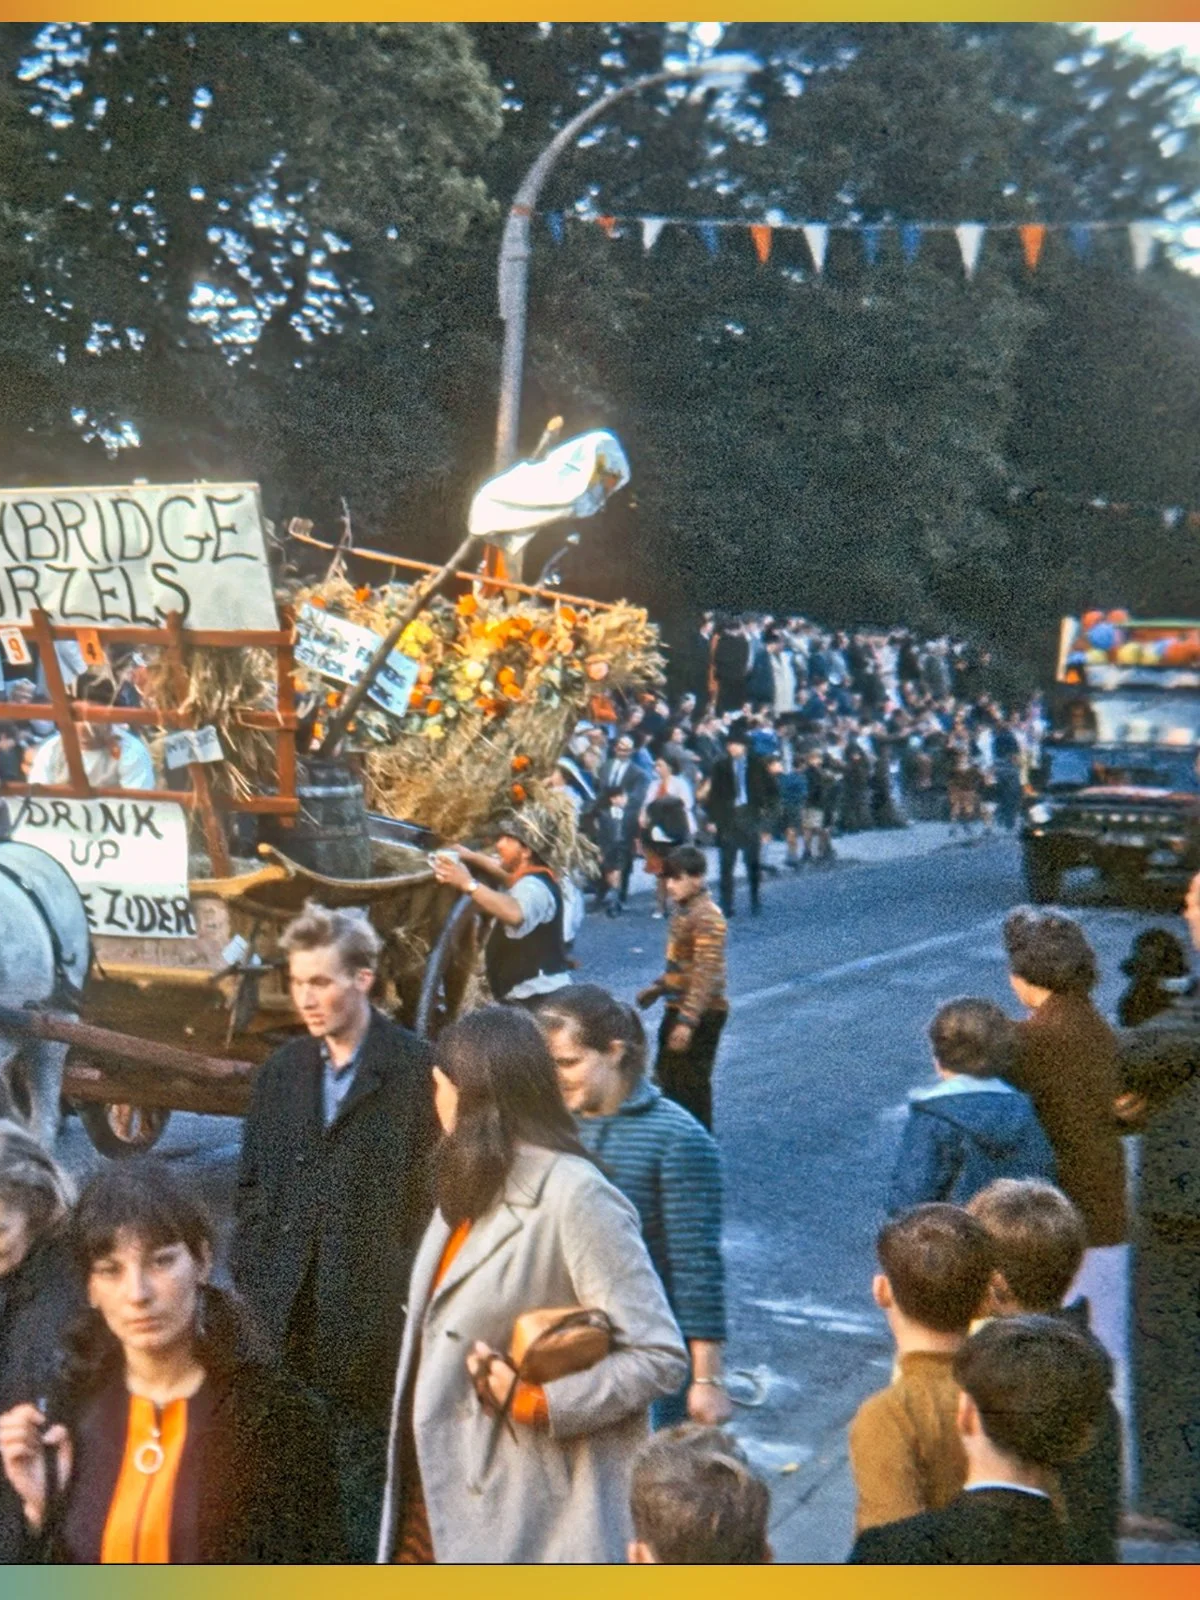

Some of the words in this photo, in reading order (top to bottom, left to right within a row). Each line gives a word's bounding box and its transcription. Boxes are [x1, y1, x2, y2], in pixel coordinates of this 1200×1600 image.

[24, 799, 163, 840] DRINK
[69, 839, 121, 869] UP
[98, 886, 197, 935] ZIDER
